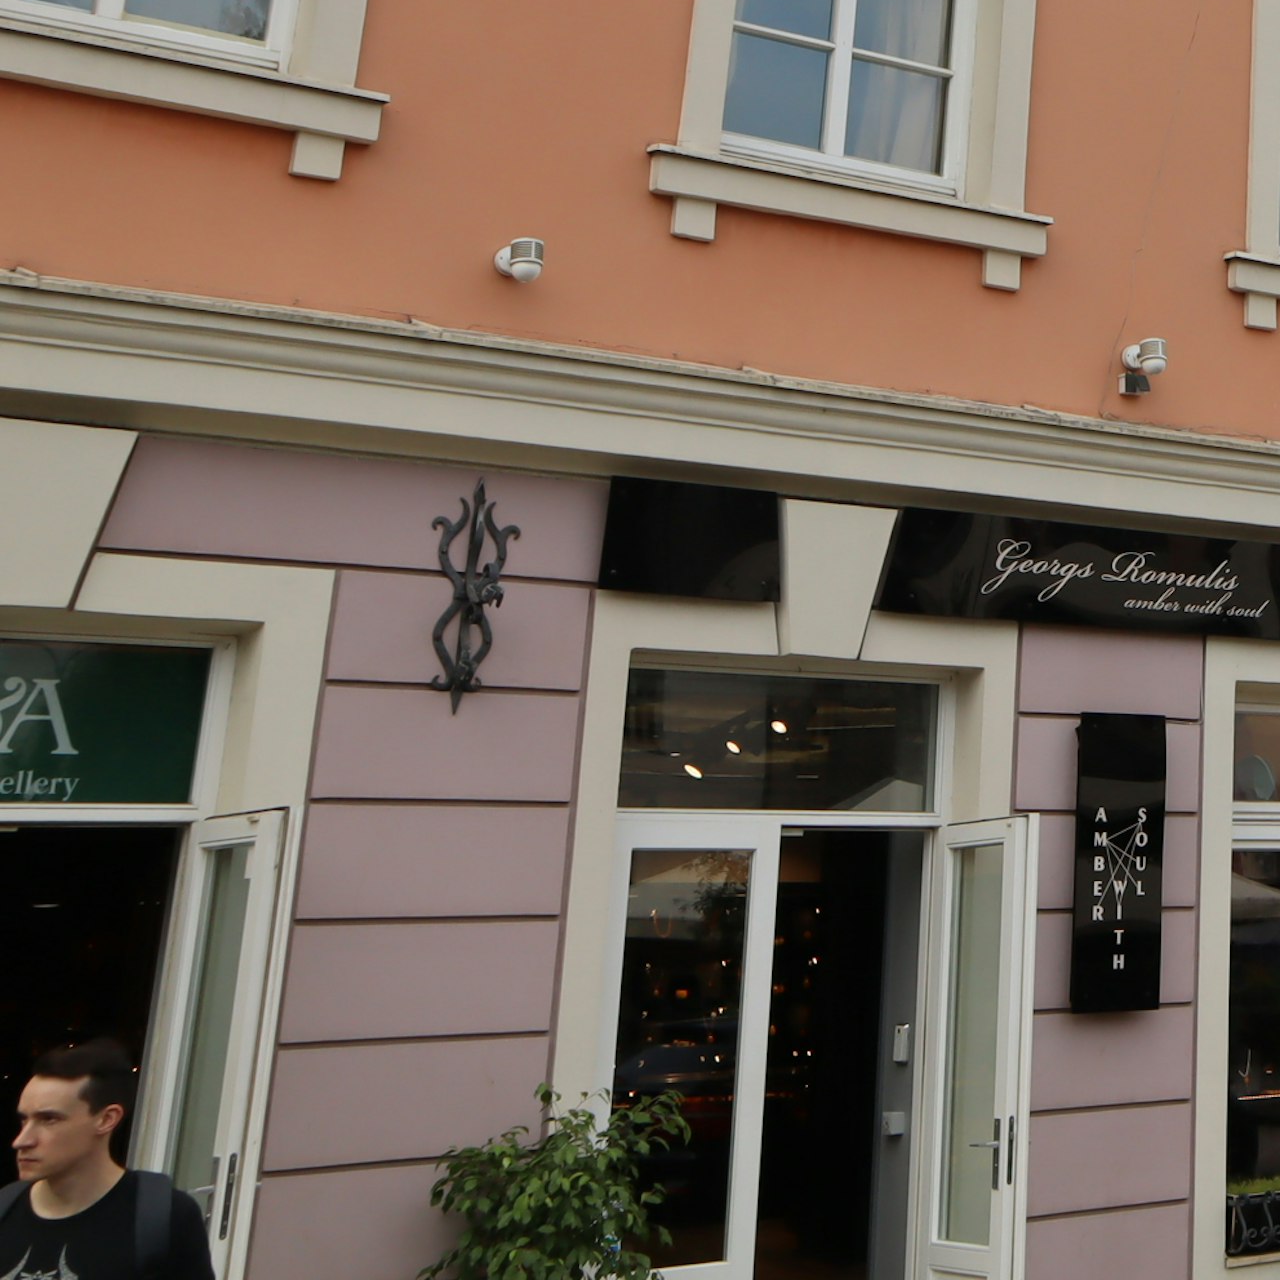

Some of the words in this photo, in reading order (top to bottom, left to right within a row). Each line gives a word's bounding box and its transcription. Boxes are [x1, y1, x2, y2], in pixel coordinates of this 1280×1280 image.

[981, 539, 1095, 602] Georgs
[1101, 552, 1240, 591] Romulis
[1124, 586, 1180, 612] amber
[1183, 591, 1224, 616] with
[1226, 599, 1270, 619] soul
[1092, 807, 1108, 920] AMBER
[1135, 807, 1148, 895] SOUL
[1112, 880, 1127, 969] WITH
